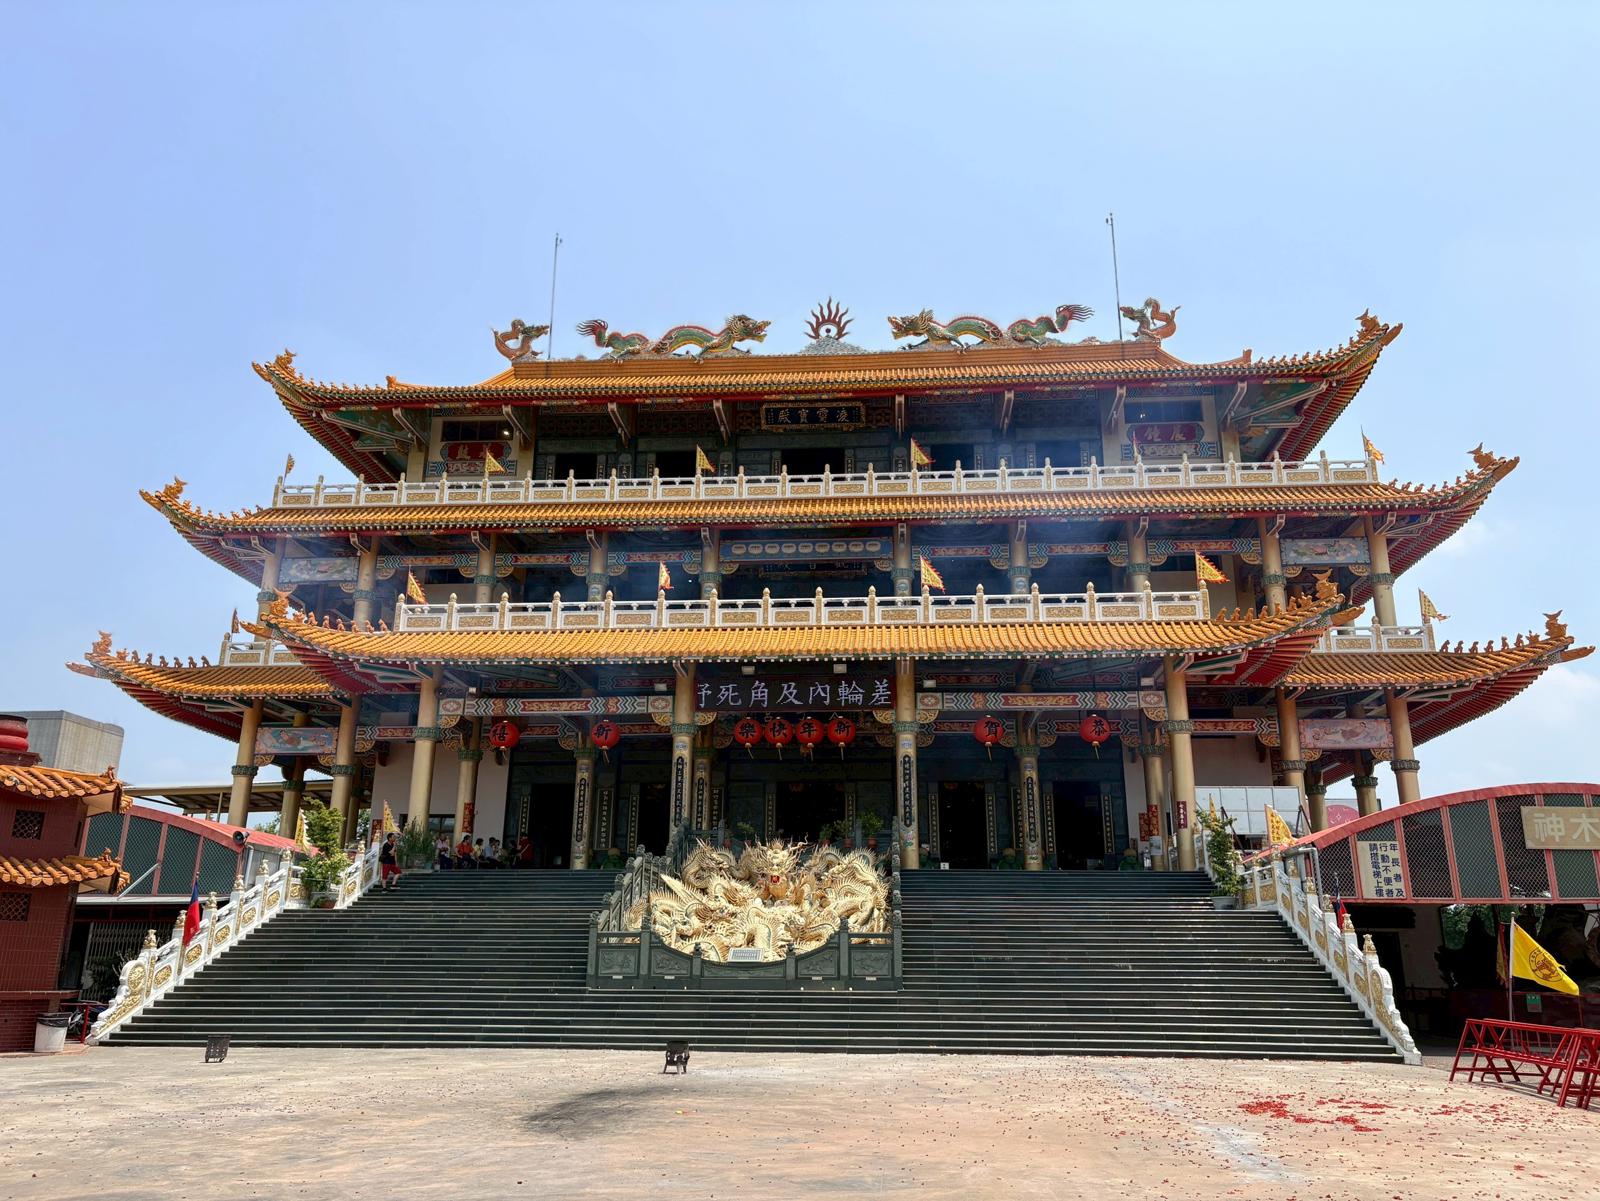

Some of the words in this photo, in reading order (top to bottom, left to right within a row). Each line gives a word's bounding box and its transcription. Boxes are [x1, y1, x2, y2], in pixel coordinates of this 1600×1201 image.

[595, 724, 611, 740] 新
[772, 720, 787, 738] 快
[800, 721, 817, 738] 年
[835, 720, 850, 737] 新
[984, 720, 1000, 737] 賀
[1090, 719, 1108, 736] 恭
[1533, 812, 1600, 843] 神木
[1369, 843, 1385, 898] 請搭電梯上樓
[1379, 842, 1394, 898] 行動不便者
[1389, 843, 1405, 898] 年長者及
